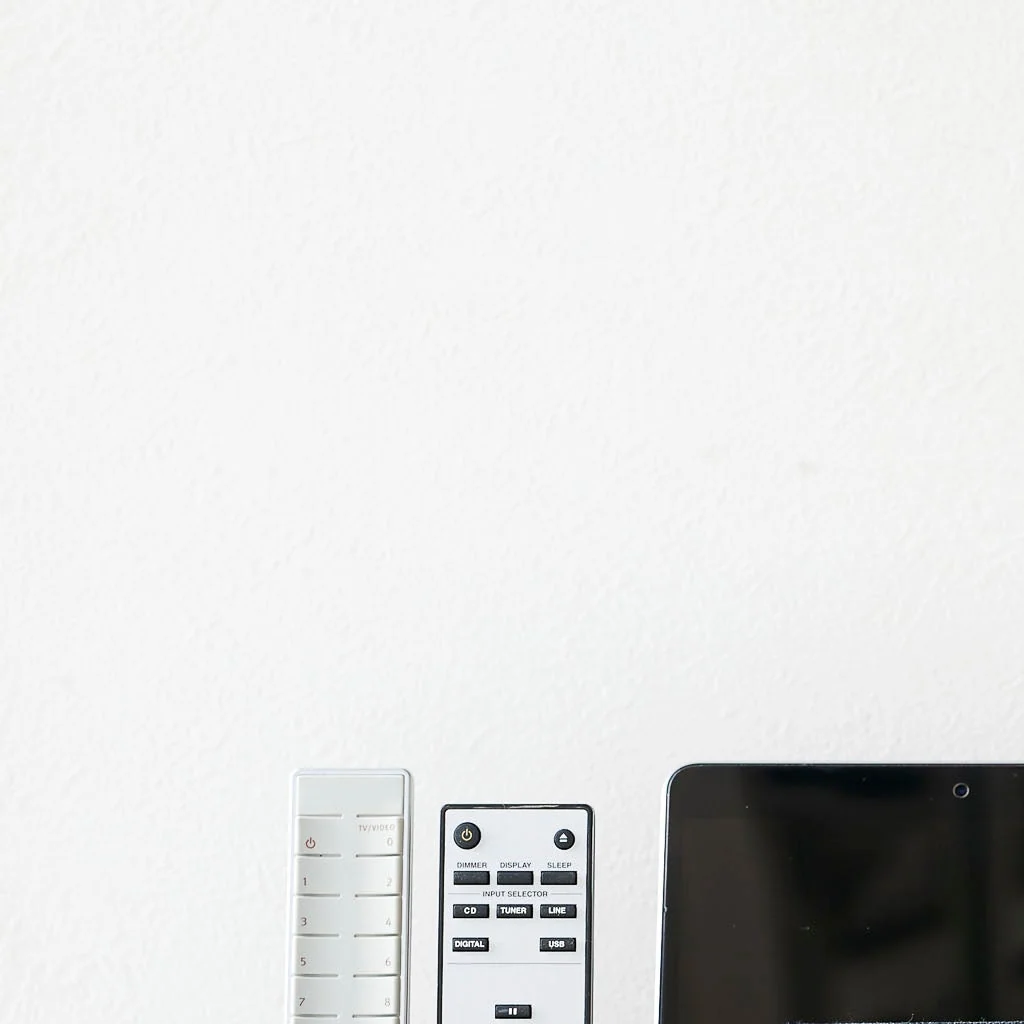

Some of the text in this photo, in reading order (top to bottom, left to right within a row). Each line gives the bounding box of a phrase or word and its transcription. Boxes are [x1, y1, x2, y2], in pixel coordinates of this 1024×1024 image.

[358, 824, 395, 832] TV/VIDEO
[303, 877, 308, 886] 1
[300, 917, 307, 926] 3
[300, 957, 306, 966] 5
[299, 997, 305, 1006] 7
